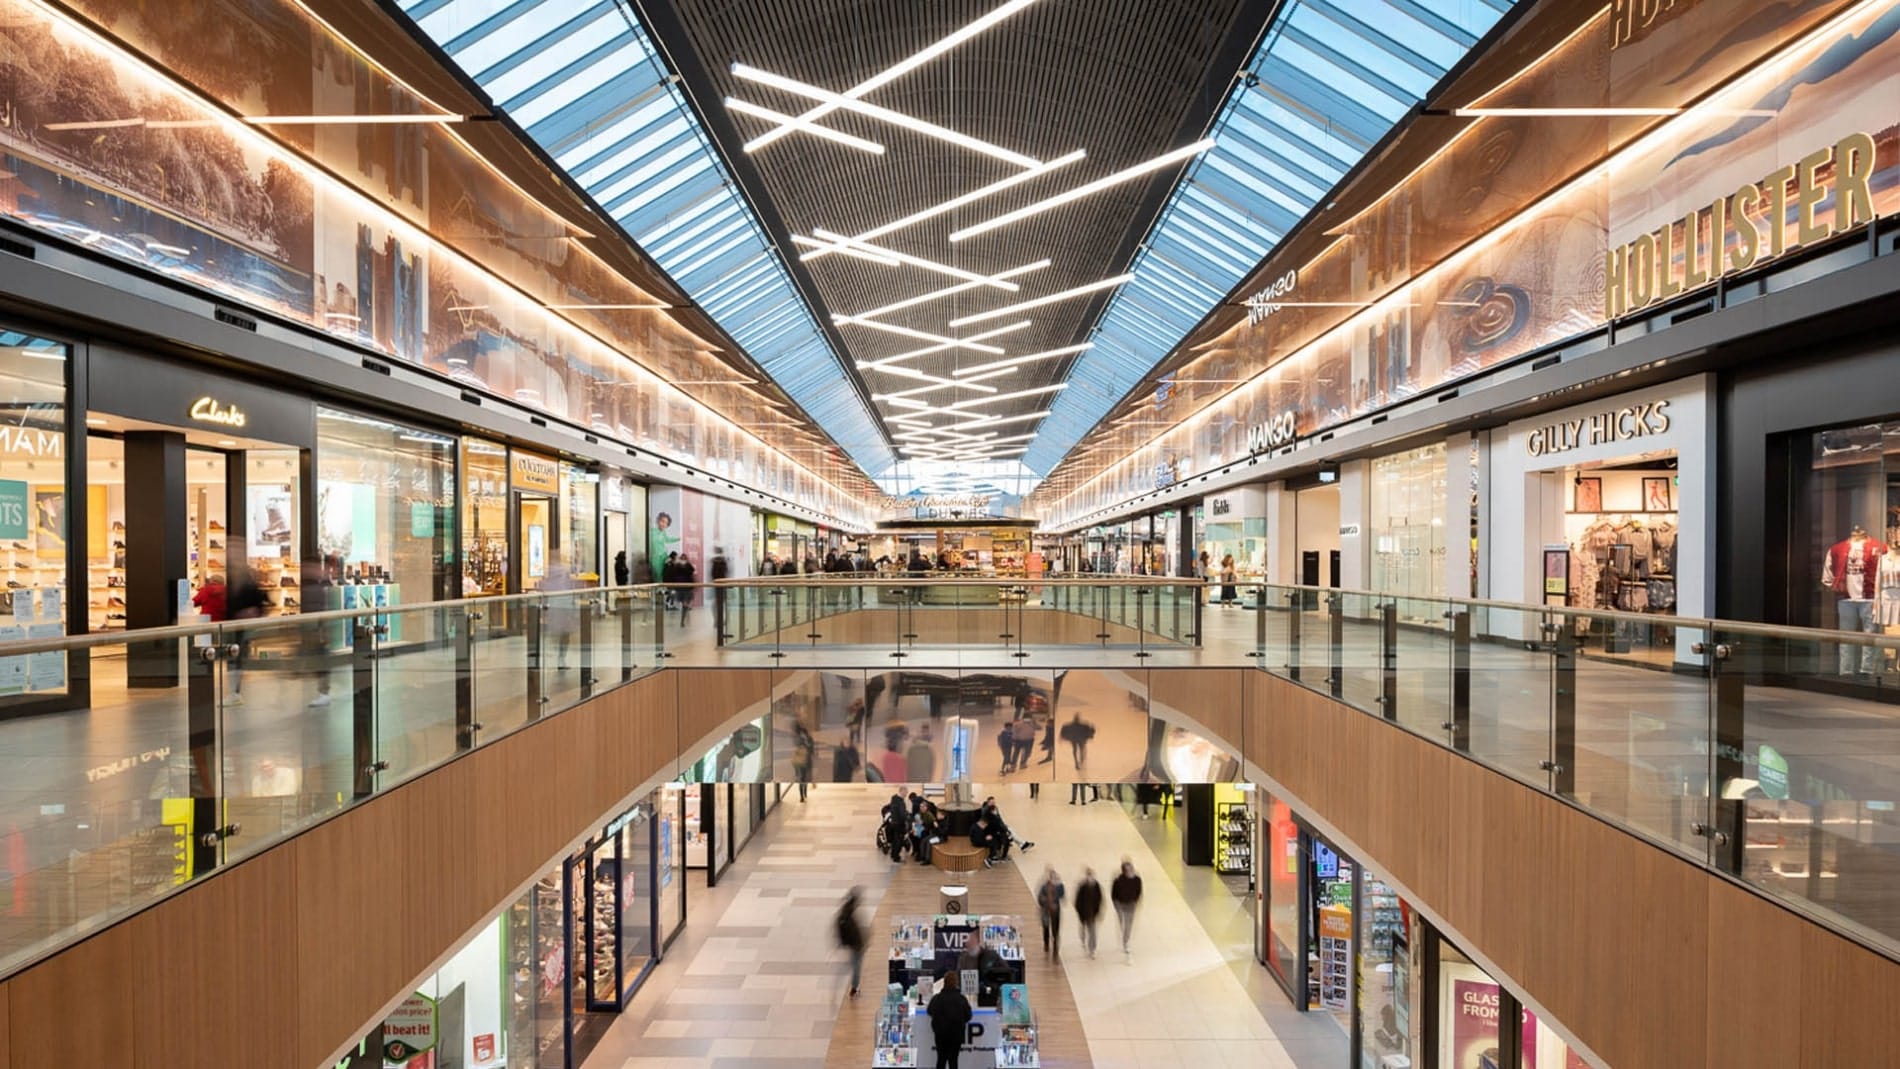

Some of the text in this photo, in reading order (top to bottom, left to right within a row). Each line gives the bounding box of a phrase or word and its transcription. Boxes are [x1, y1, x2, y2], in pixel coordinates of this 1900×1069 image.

[1605, 131, 1877, 319] HOLLISTER
[189, 395, 246, 427] Clarks
[1527, 400, 1670, 457] GILLY HICKS
[1248, 410, 1294, 451] MANGO
[942, 932, 969, 948] VIP
[393, 1024, 416, 1035] beat
[418, 1023, 430, 1035] it!
